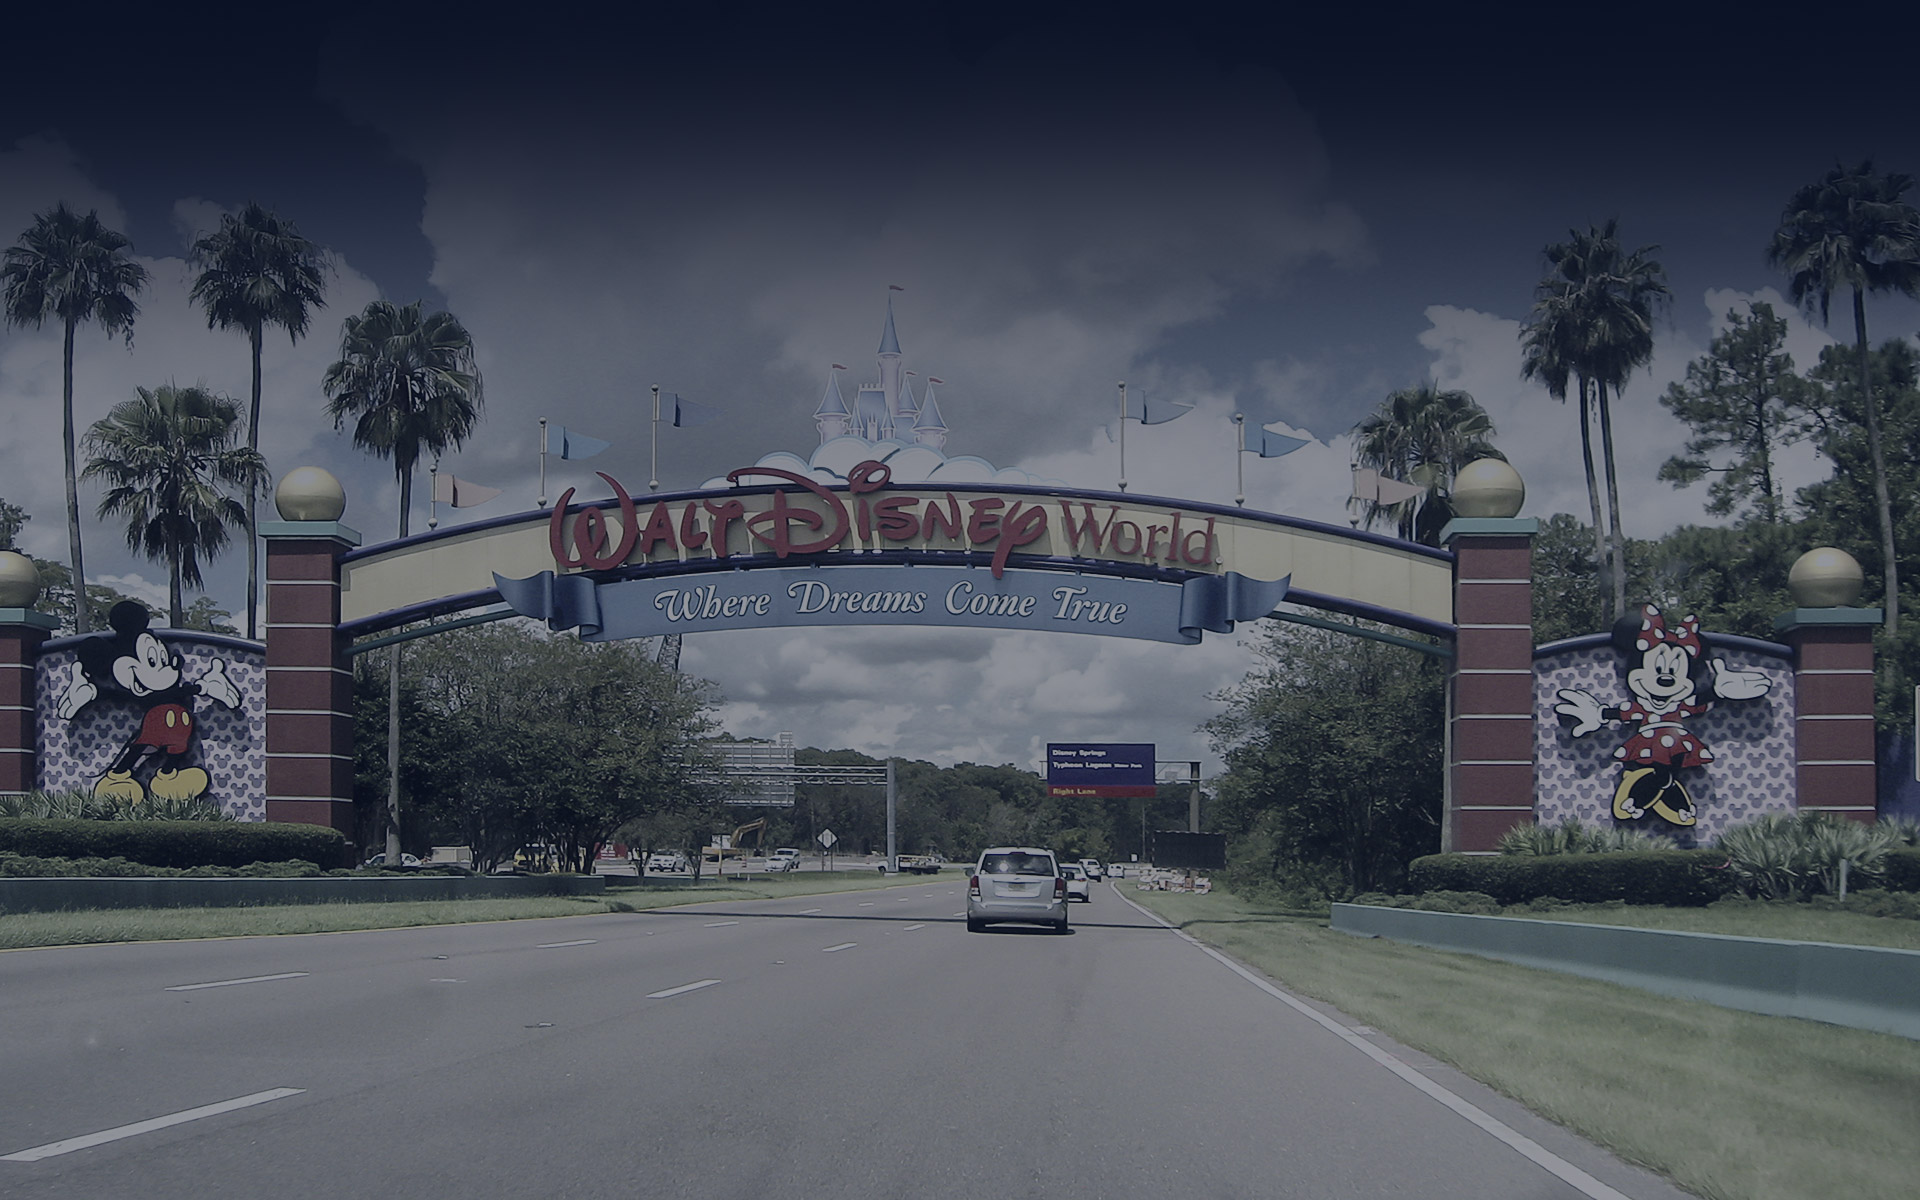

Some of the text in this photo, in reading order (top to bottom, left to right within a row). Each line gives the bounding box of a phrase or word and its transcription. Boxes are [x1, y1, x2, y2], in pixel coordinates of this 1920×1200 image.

[1057, 499, 1217, 566] World
[653, 579, 1128, 626] Where Dreams Come True
[1052, 749, 1107, 758] Disney Springs
[1085, 761, 1112, 770] Lagoon
[1052, 788, 1097, 796] Right Lane
